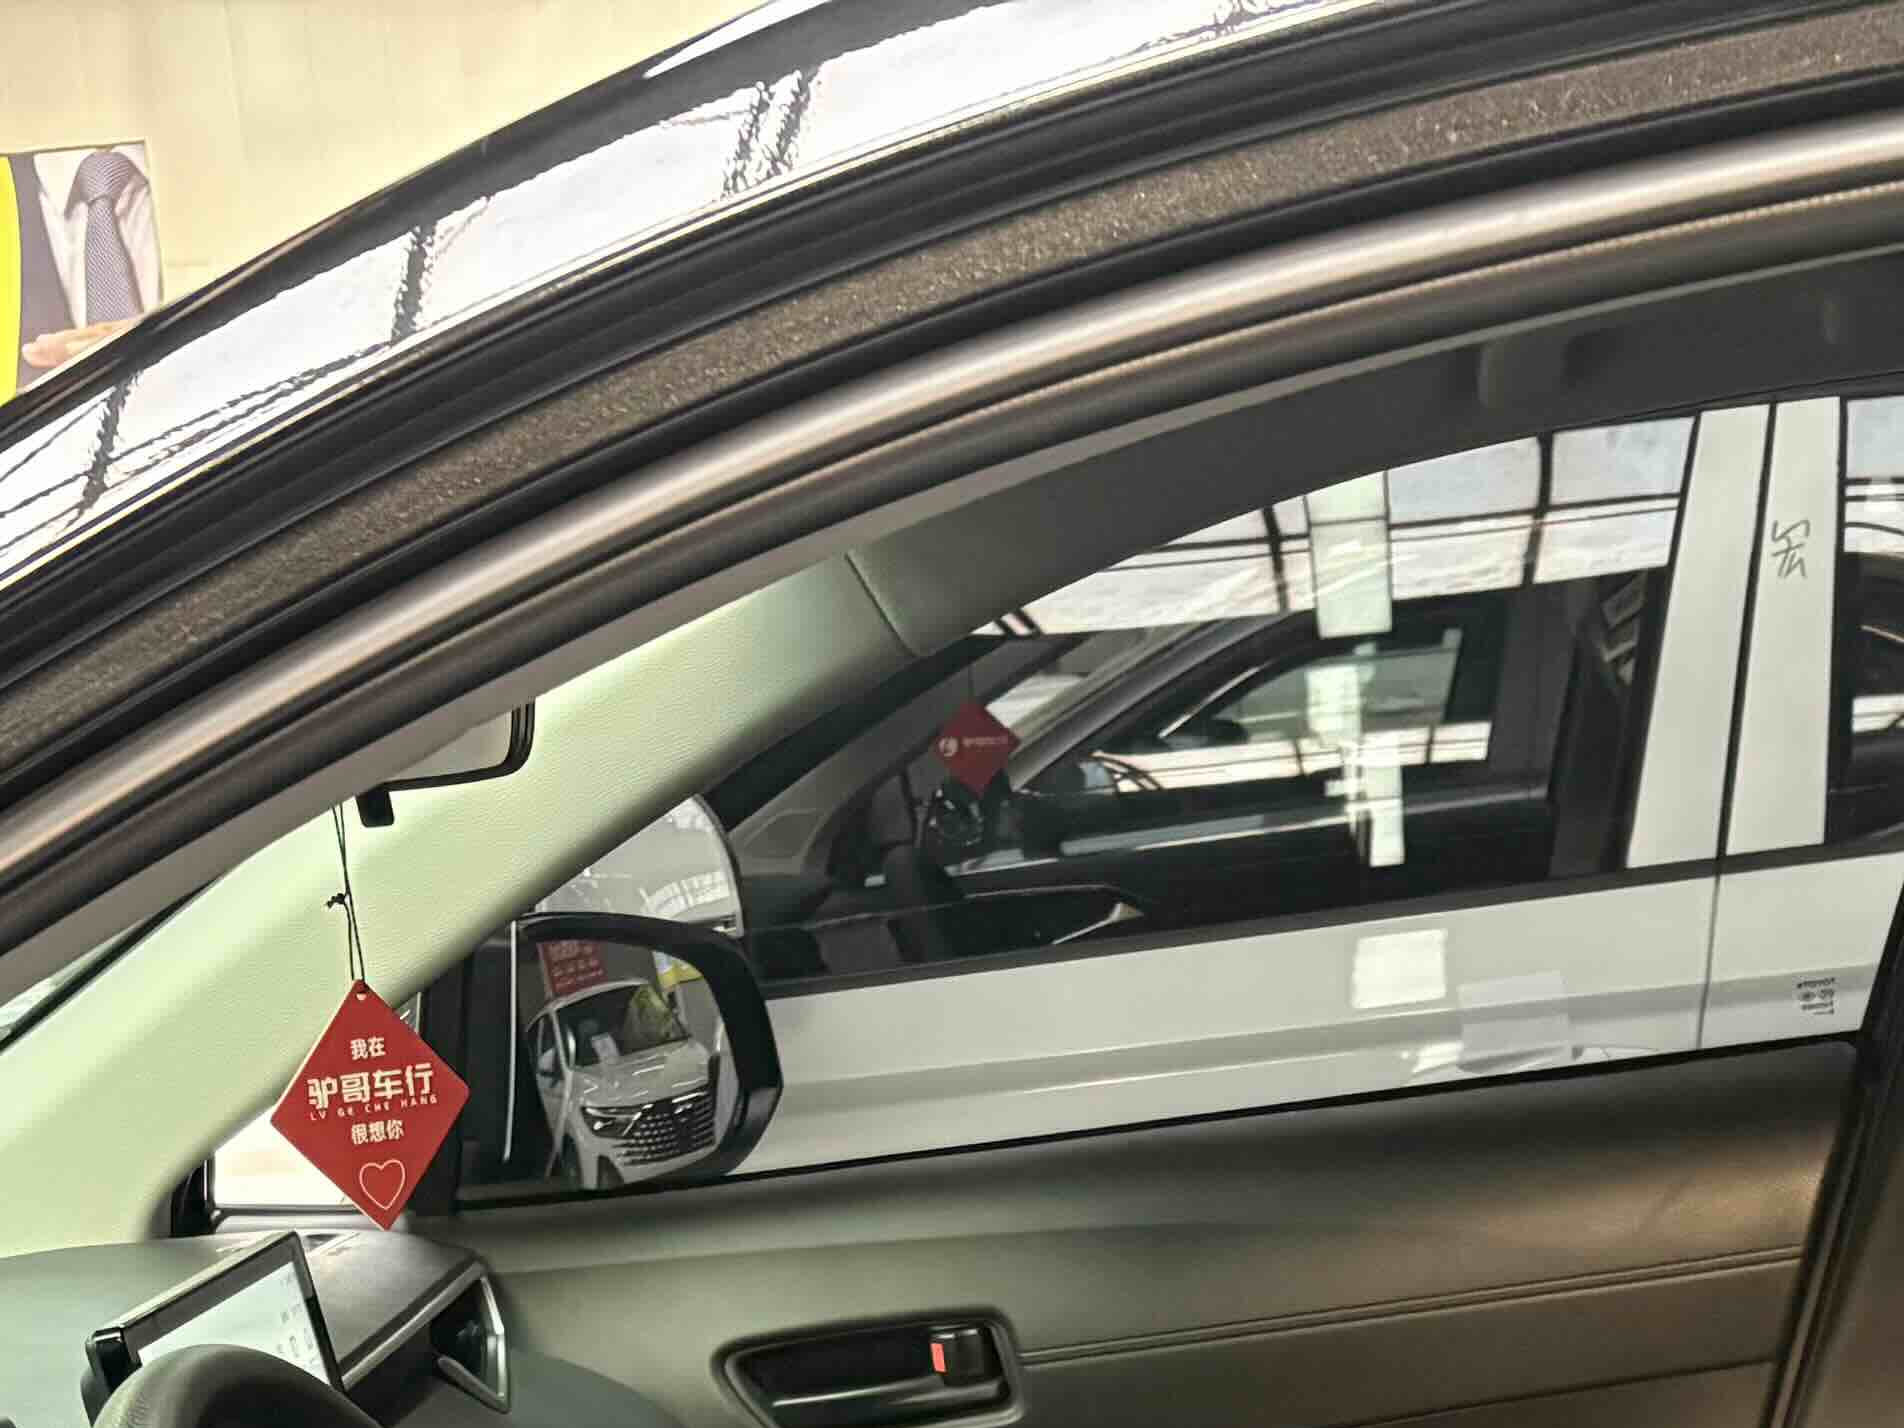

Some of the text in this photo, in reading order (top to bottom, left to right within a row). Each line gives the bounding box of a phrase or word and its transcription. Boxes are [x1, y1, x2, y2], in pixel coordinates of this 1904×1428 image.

[350, 1036, 386, 1061] 我在
[307, 1063, 434, 1109] 驴哥车行
[400, 1094, 438, 1109] HANG
[351, 1119, 404, 1145] 很想你
